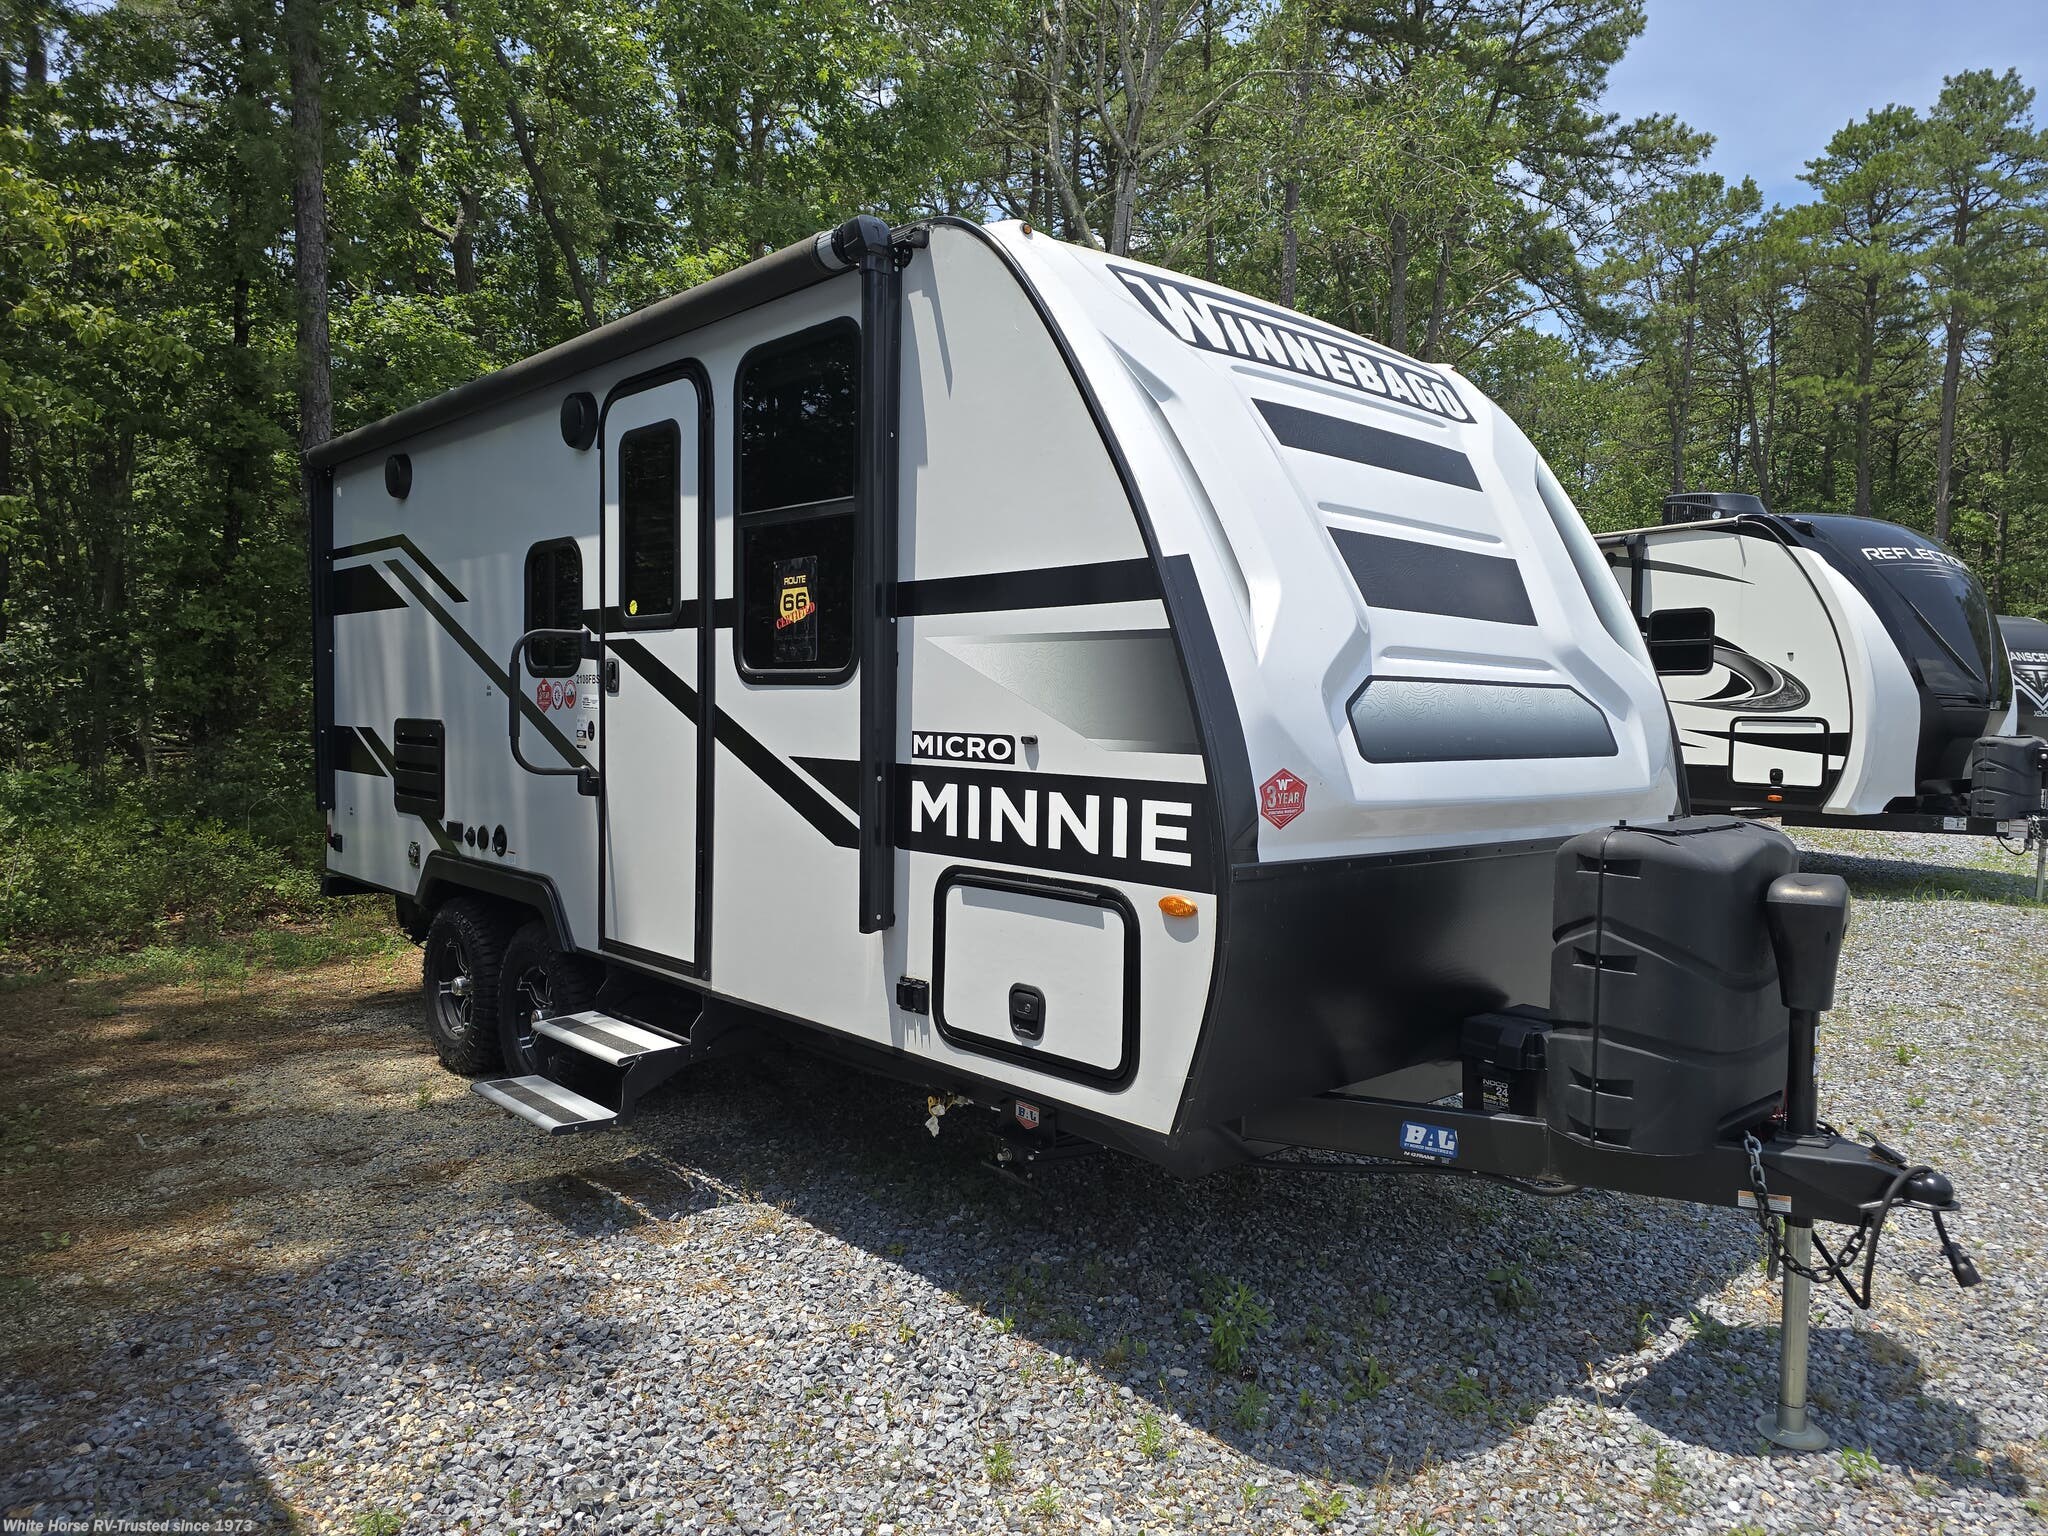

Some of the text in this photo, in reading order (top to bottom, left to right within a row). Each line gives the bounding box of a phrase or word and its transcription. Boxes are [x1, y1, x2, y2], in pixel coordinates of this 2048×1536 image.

[1117, 271, 1463, 421] WINNEBAGO
[784, 575, 807, 586] ROUTE
[783, 592, 807, 612] 66
[913, 734, 1012, 761] MICRO
[1267, 786, 1300, 807] 3 YEAR
[911, 780, 1193, 867] MINNIE
[1496, 1086, 1509, 1098] 24
